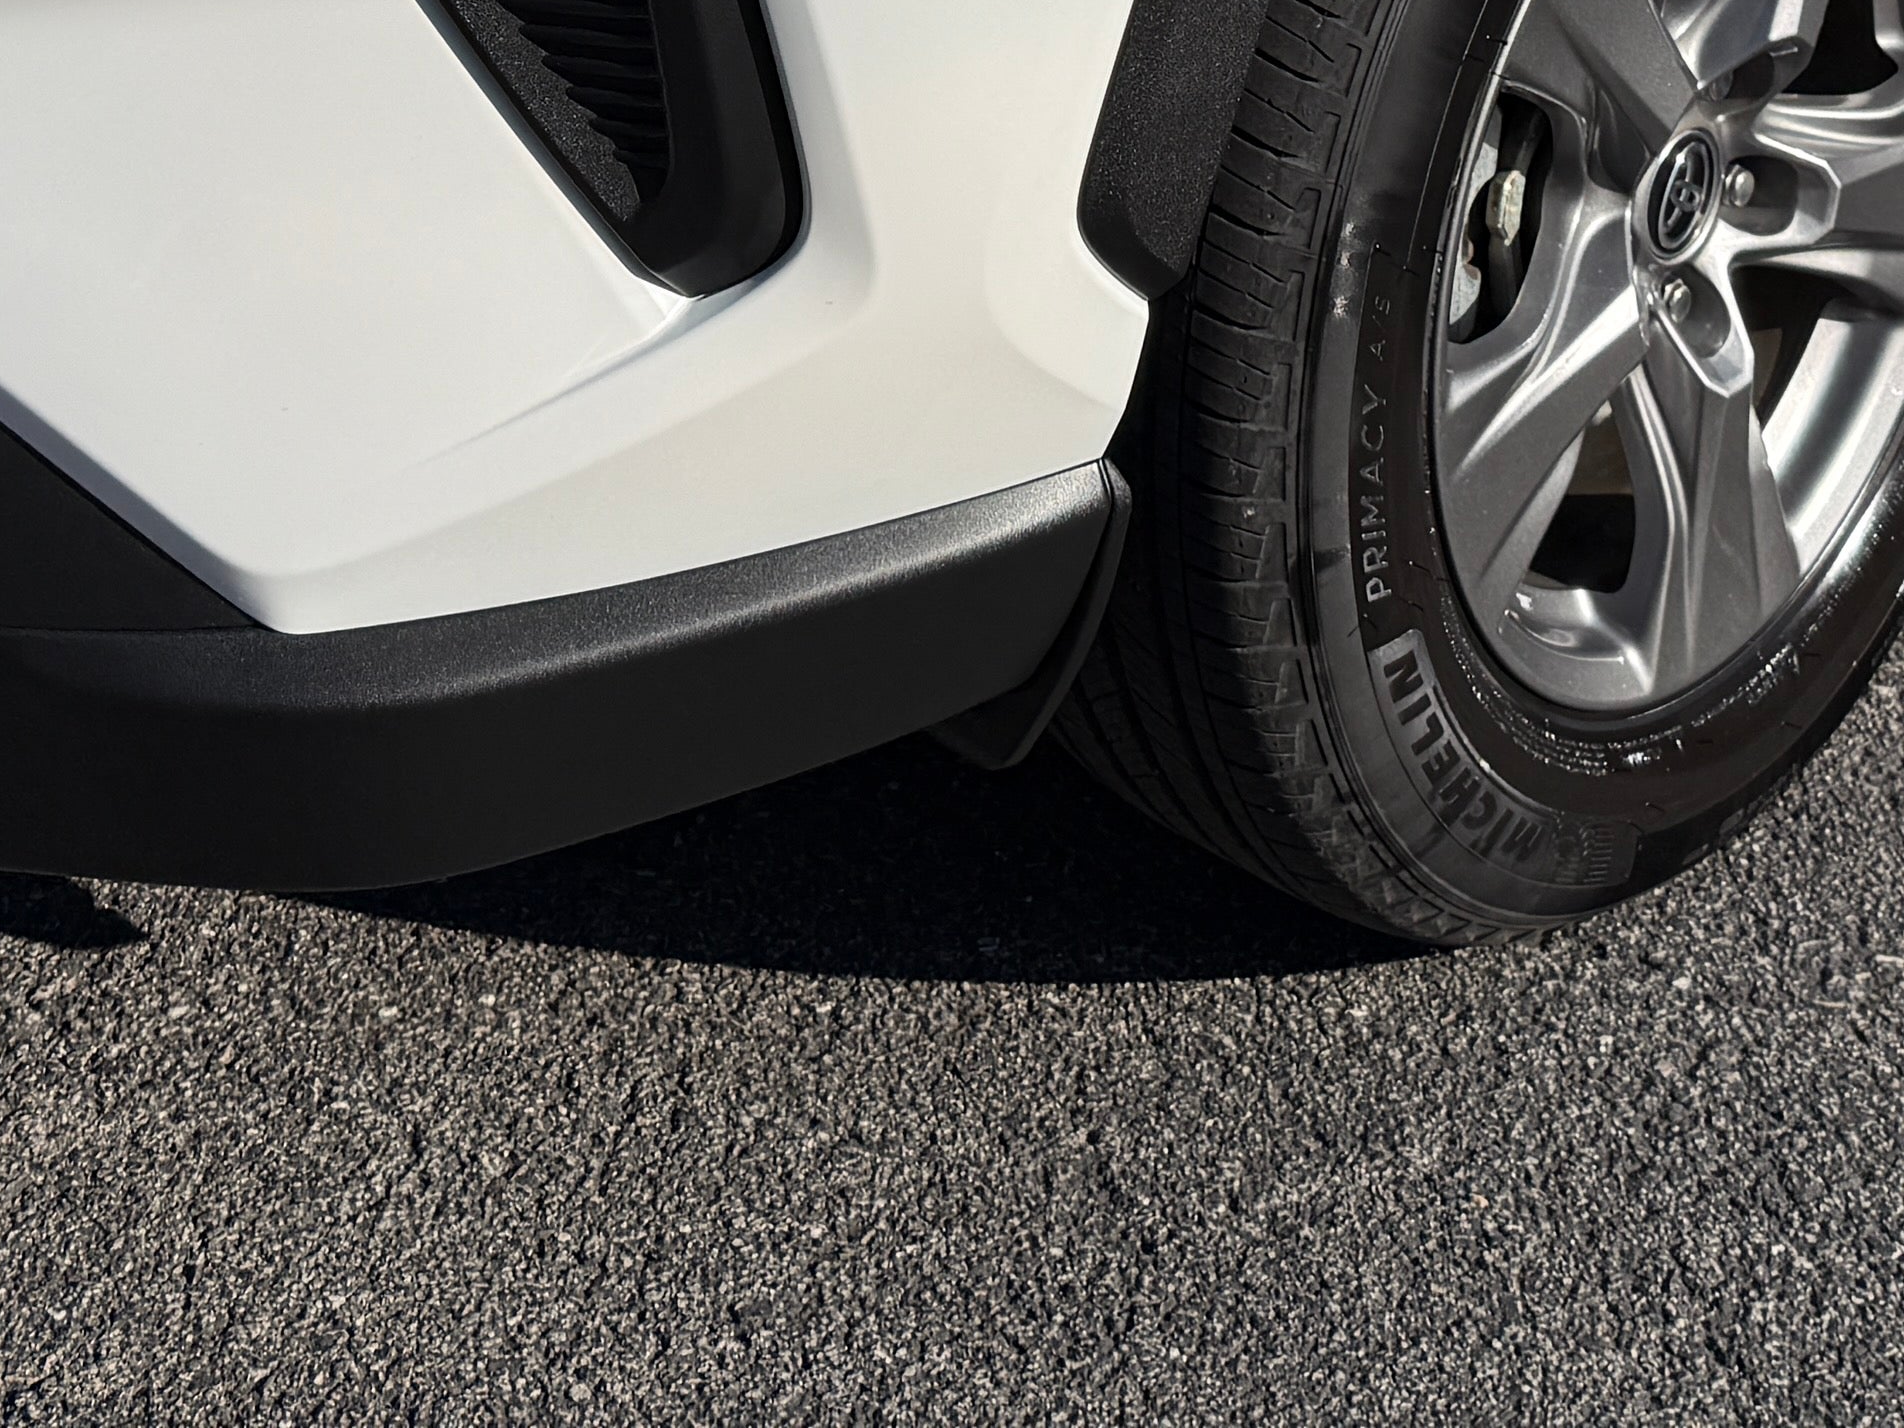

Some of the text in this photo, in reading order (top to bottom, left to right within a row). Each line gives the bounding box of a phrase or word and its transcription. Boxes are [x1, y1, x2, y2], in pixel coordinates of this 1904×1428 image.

[1360, 295, 1392, 603] PRIMACY A/S
[1382, 649, 1544, 863] MICHELIN
